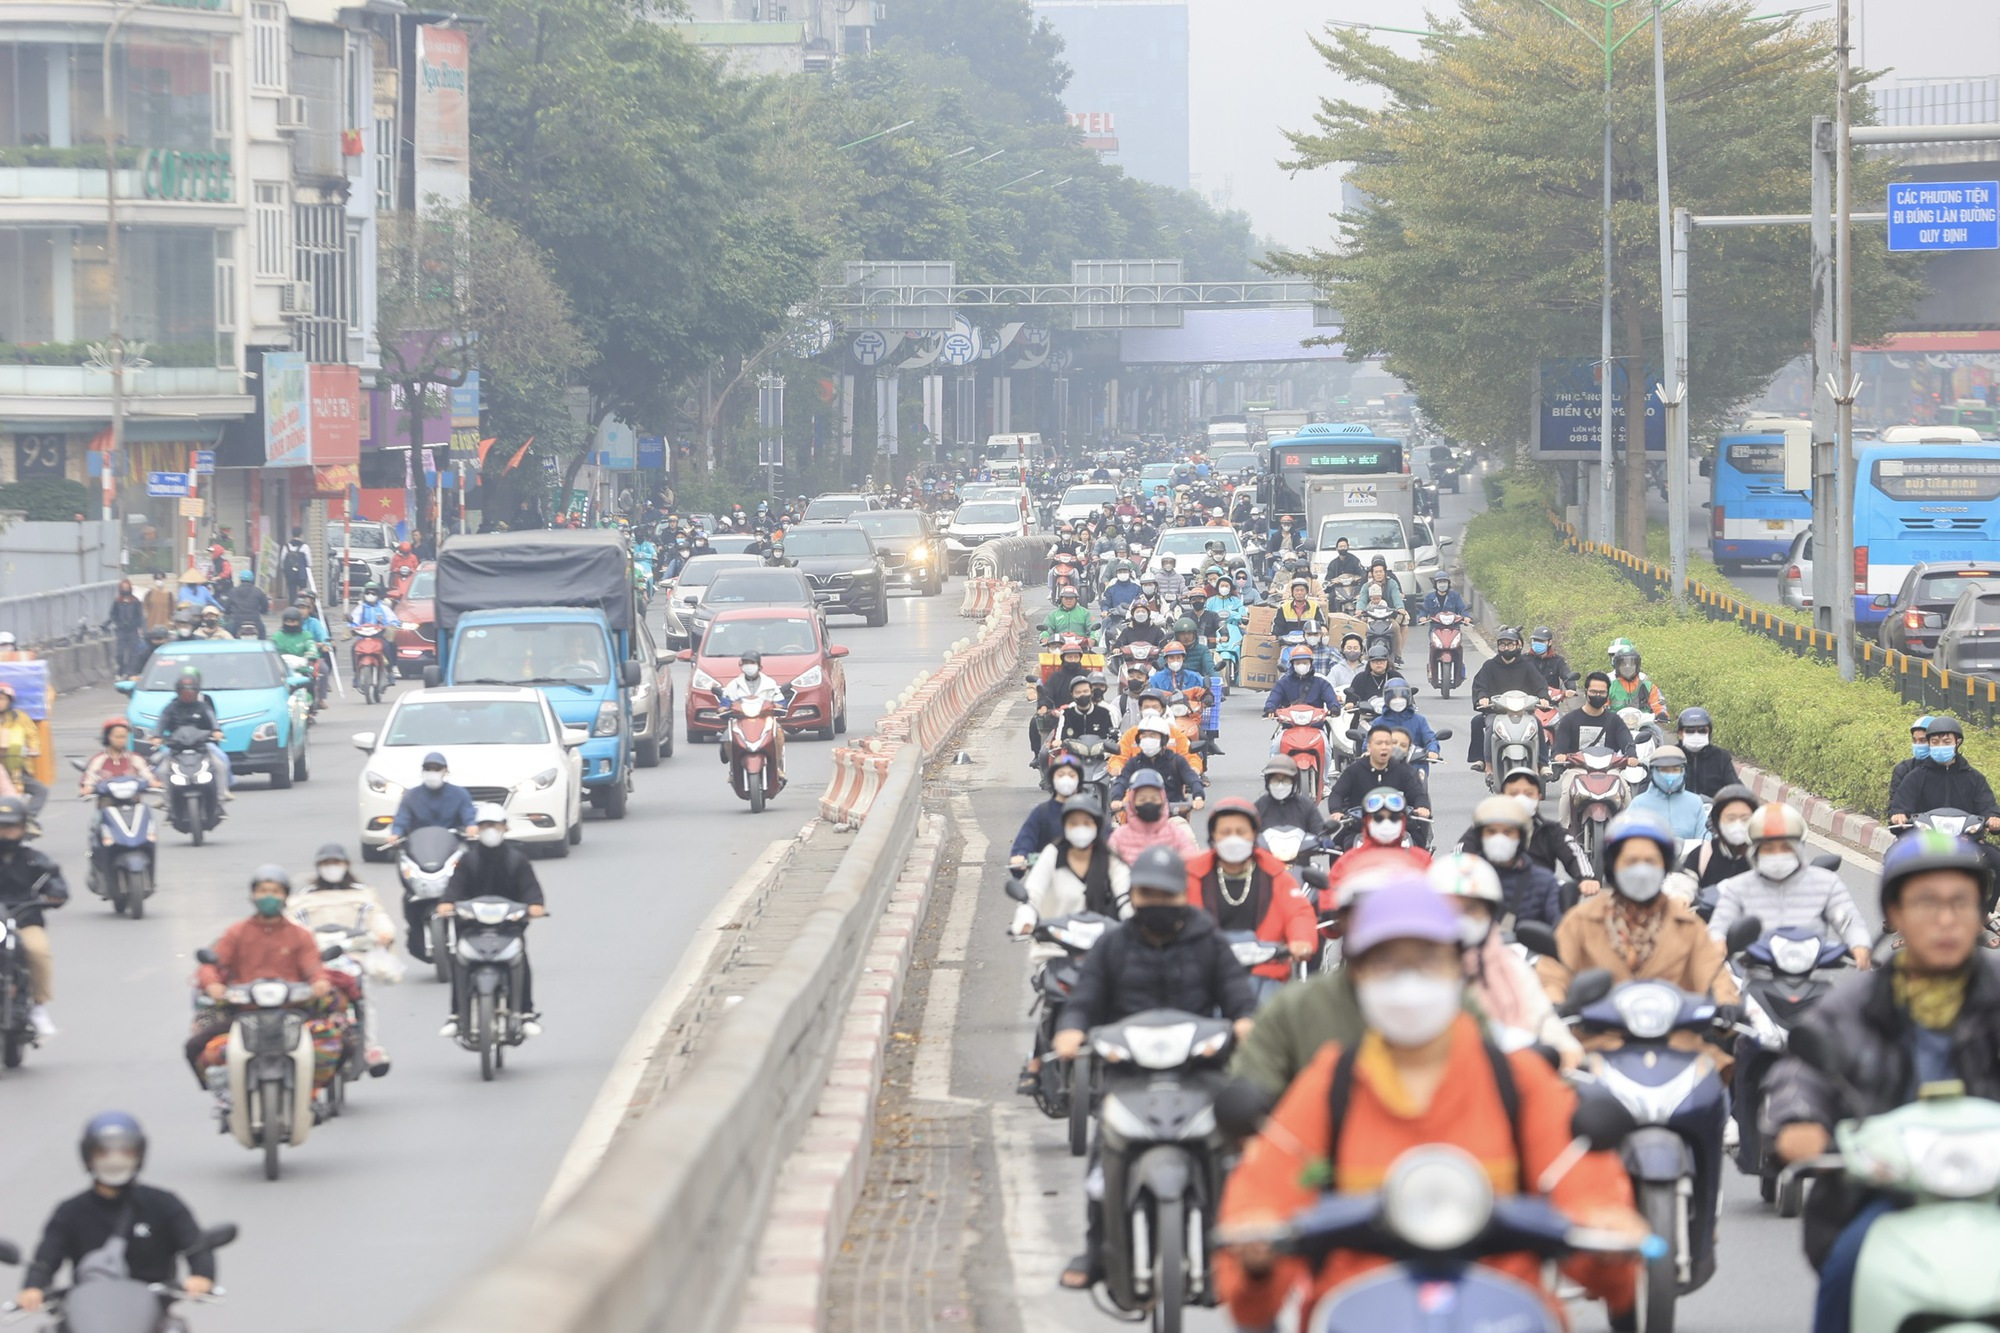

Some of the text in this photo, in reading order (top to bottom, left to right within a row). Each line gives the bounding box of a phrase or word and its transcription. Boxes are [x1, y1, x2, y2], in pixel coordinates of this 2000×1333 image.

[145, 149, 231, 185] COFFEE
[1897, 187, 1988, 204] CÁC PHƯƠNG TIỆN
[1893, 205, 1996, 224] ĐI ĐÚNG LÀN ĐƯỜNG
[1920, 228, 1967, 244] QUY ĐỊNH
[1556, 393, 1571, 401] THI
[1575, 391, 1602, 401] CNG
[1552, 403, 1626, 419] BIỂN QUNG
[1569, 434, 1588, 442] 098
[22, 435, 60, 467] 93
[1285, 454, 1300, 465] 02
[1905, 479, 1924, 488] BUS
